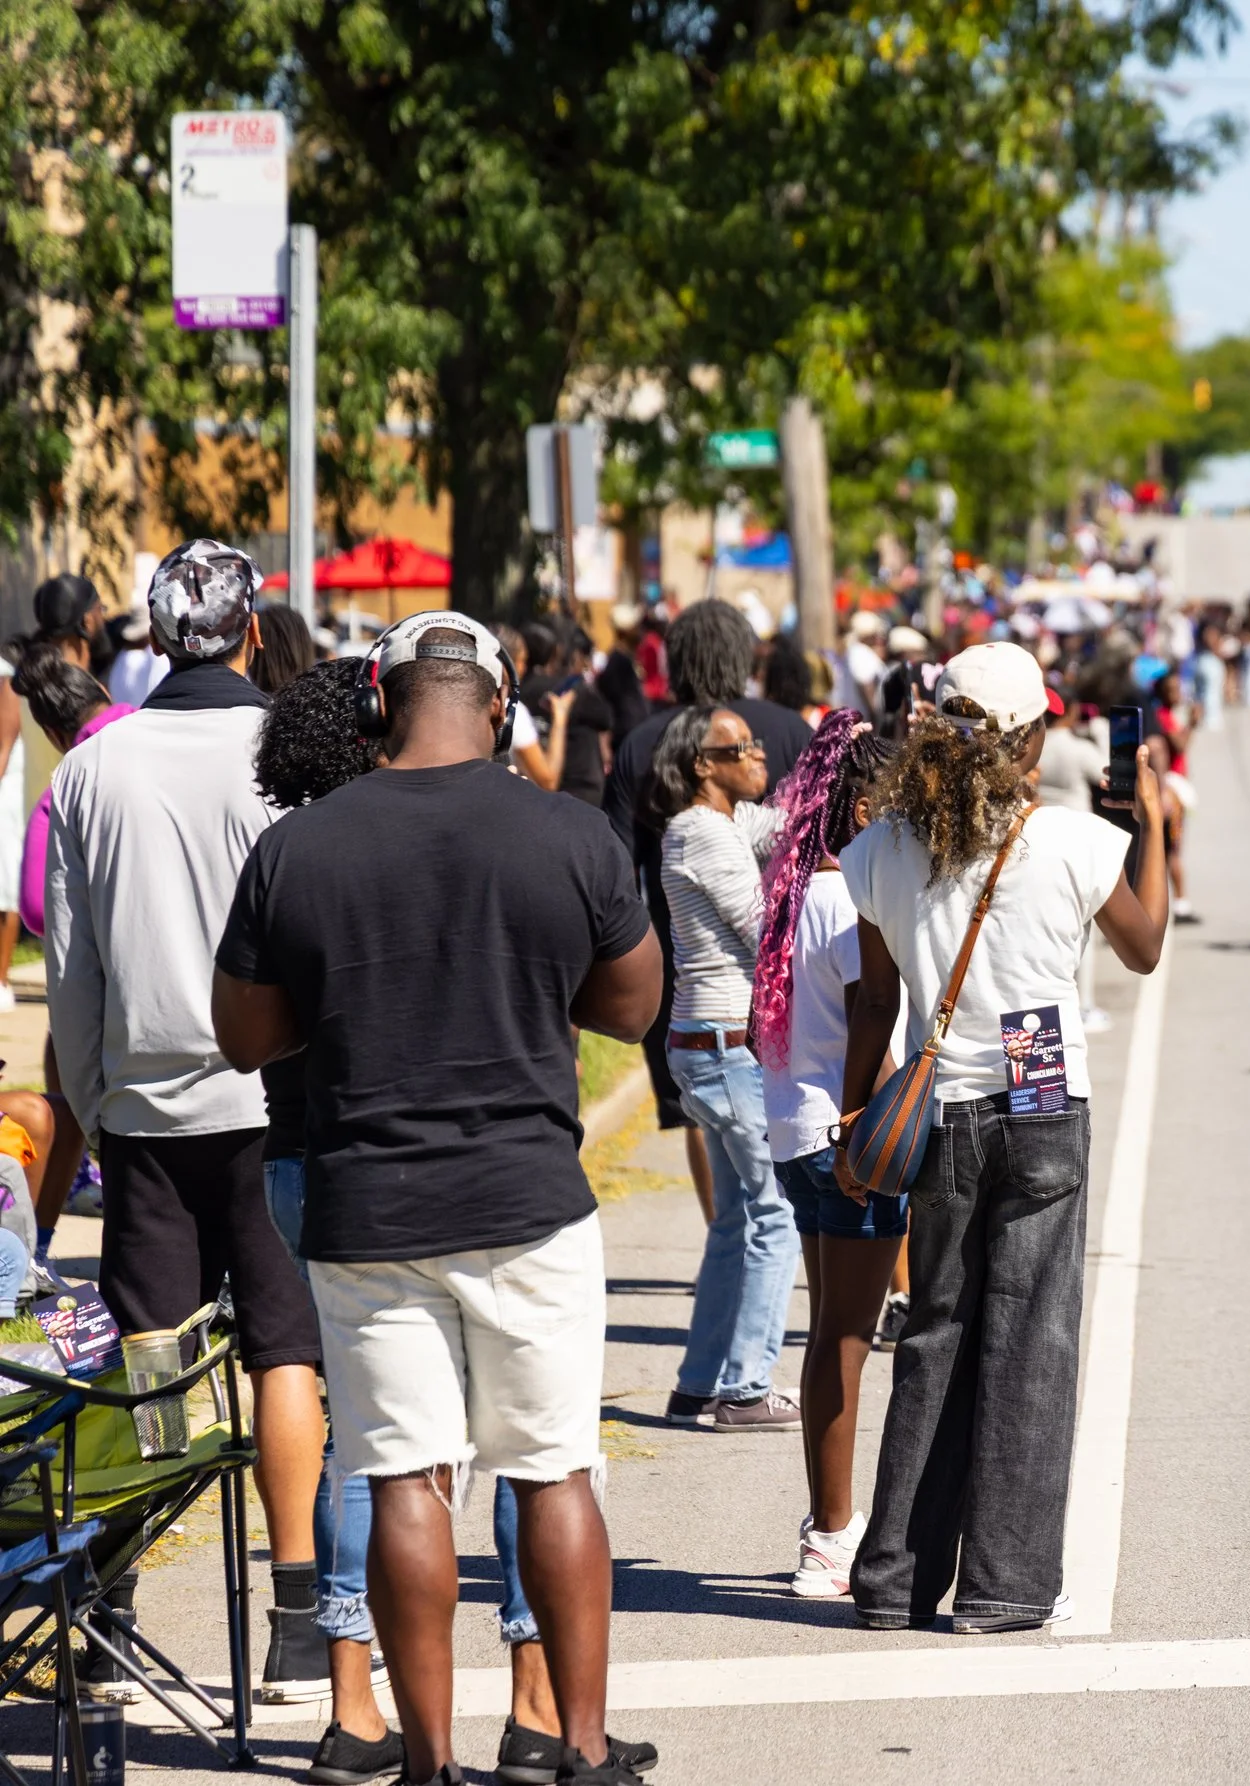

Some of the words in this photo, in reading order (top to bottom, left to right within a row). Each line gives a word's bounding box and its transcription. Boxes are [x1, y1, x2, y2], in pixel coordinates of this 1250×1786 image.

[1032, 1043, 1063, 1055] Garrett
[1042, 1053, 1055, 1062] Sr.
[1010, 1088, 1037, 1097] LEADERSHIP
[1012, 1096, 1030, 1104] SERVICE
[1012, 1103, 1037, 1112] COMMUNITY
